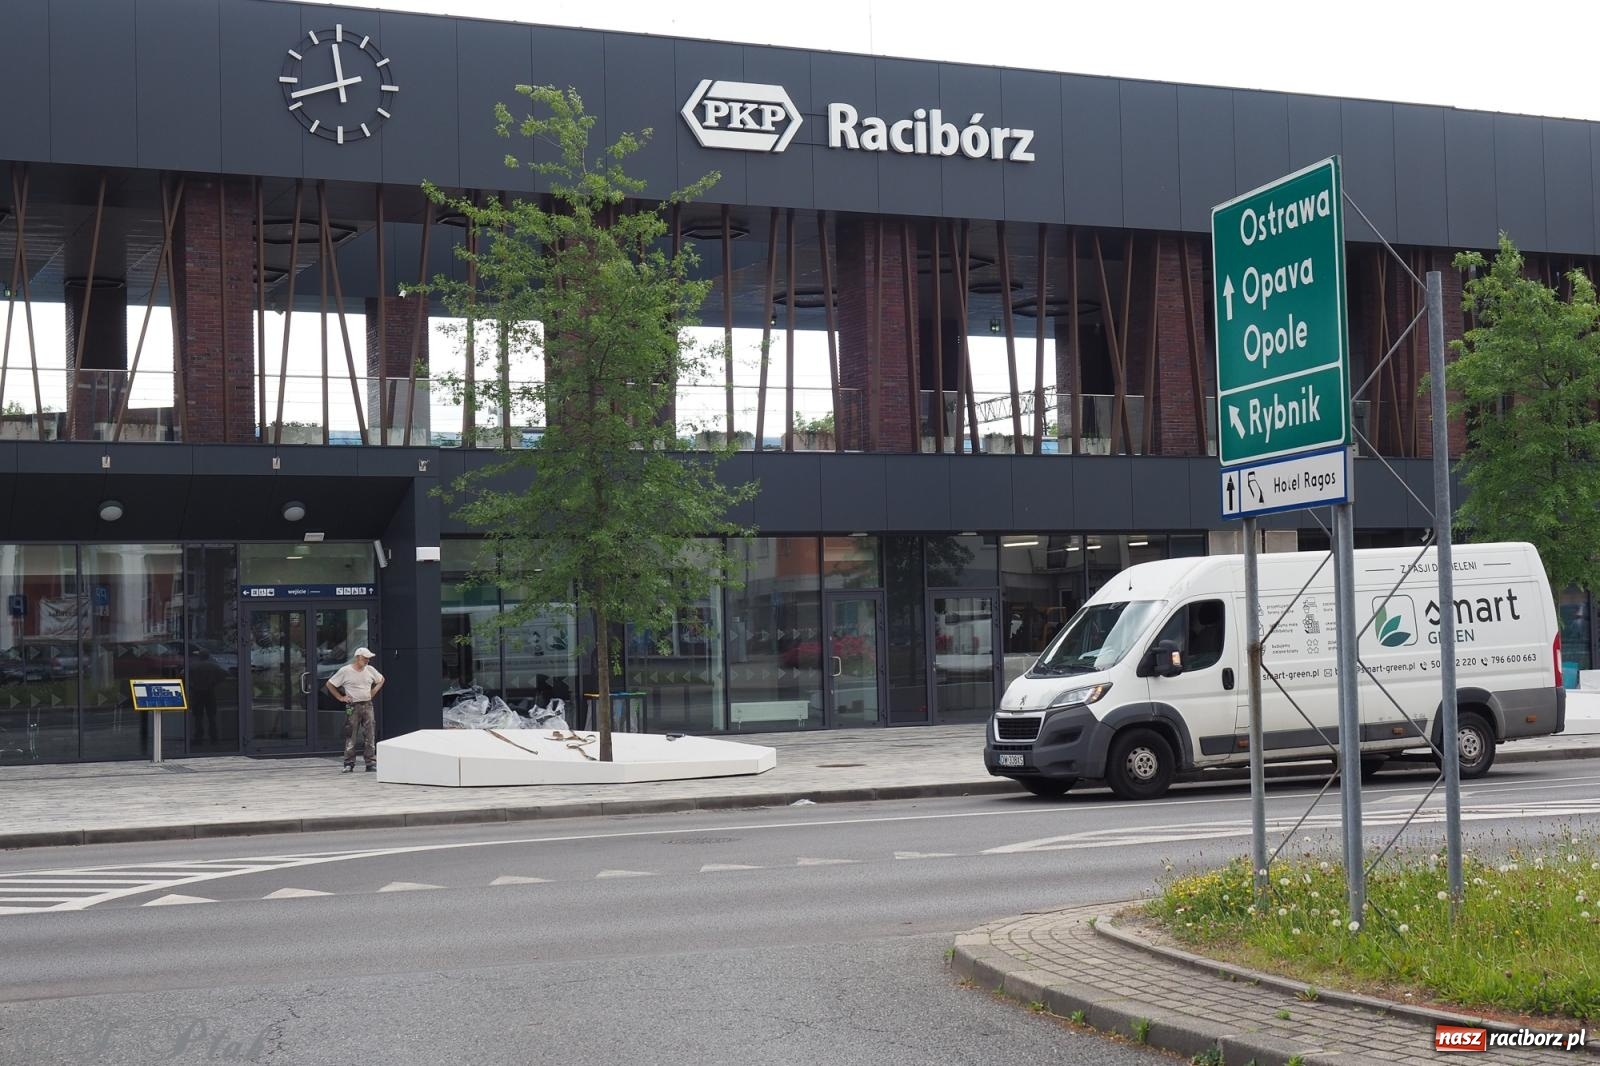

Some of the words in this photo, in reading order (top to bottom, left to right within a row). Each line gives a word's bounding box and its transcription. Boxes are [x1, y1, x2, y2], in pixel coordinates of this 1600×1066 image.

[702, 99, 786, 132] PKP
[827, 102, 1036, 162] Racibórz
[1240, 189, 1330, 246] Ostrawa
[1242, 257, 1314, 311] Opava
[1243, 313, 1308, 369] Opole
[1249, 384, 1321, 443] Rybnik
[1274, 475, 1300, 493] Hotel
[1304, 471, 1336, 491] Ragos
[1400, 564, 1407, 574] Z
[1451, 561, 1477, 571] IELENI
[1425, 588, 1520, 626] smart
[1428, 629, 1475, 645] GEN
[1462, 658, 1477, 667] 220
[1491, 656, 1505, 665] 796
[1506, 654, 1521, 664] 600
[1522, 653, 1537, 662] 663
